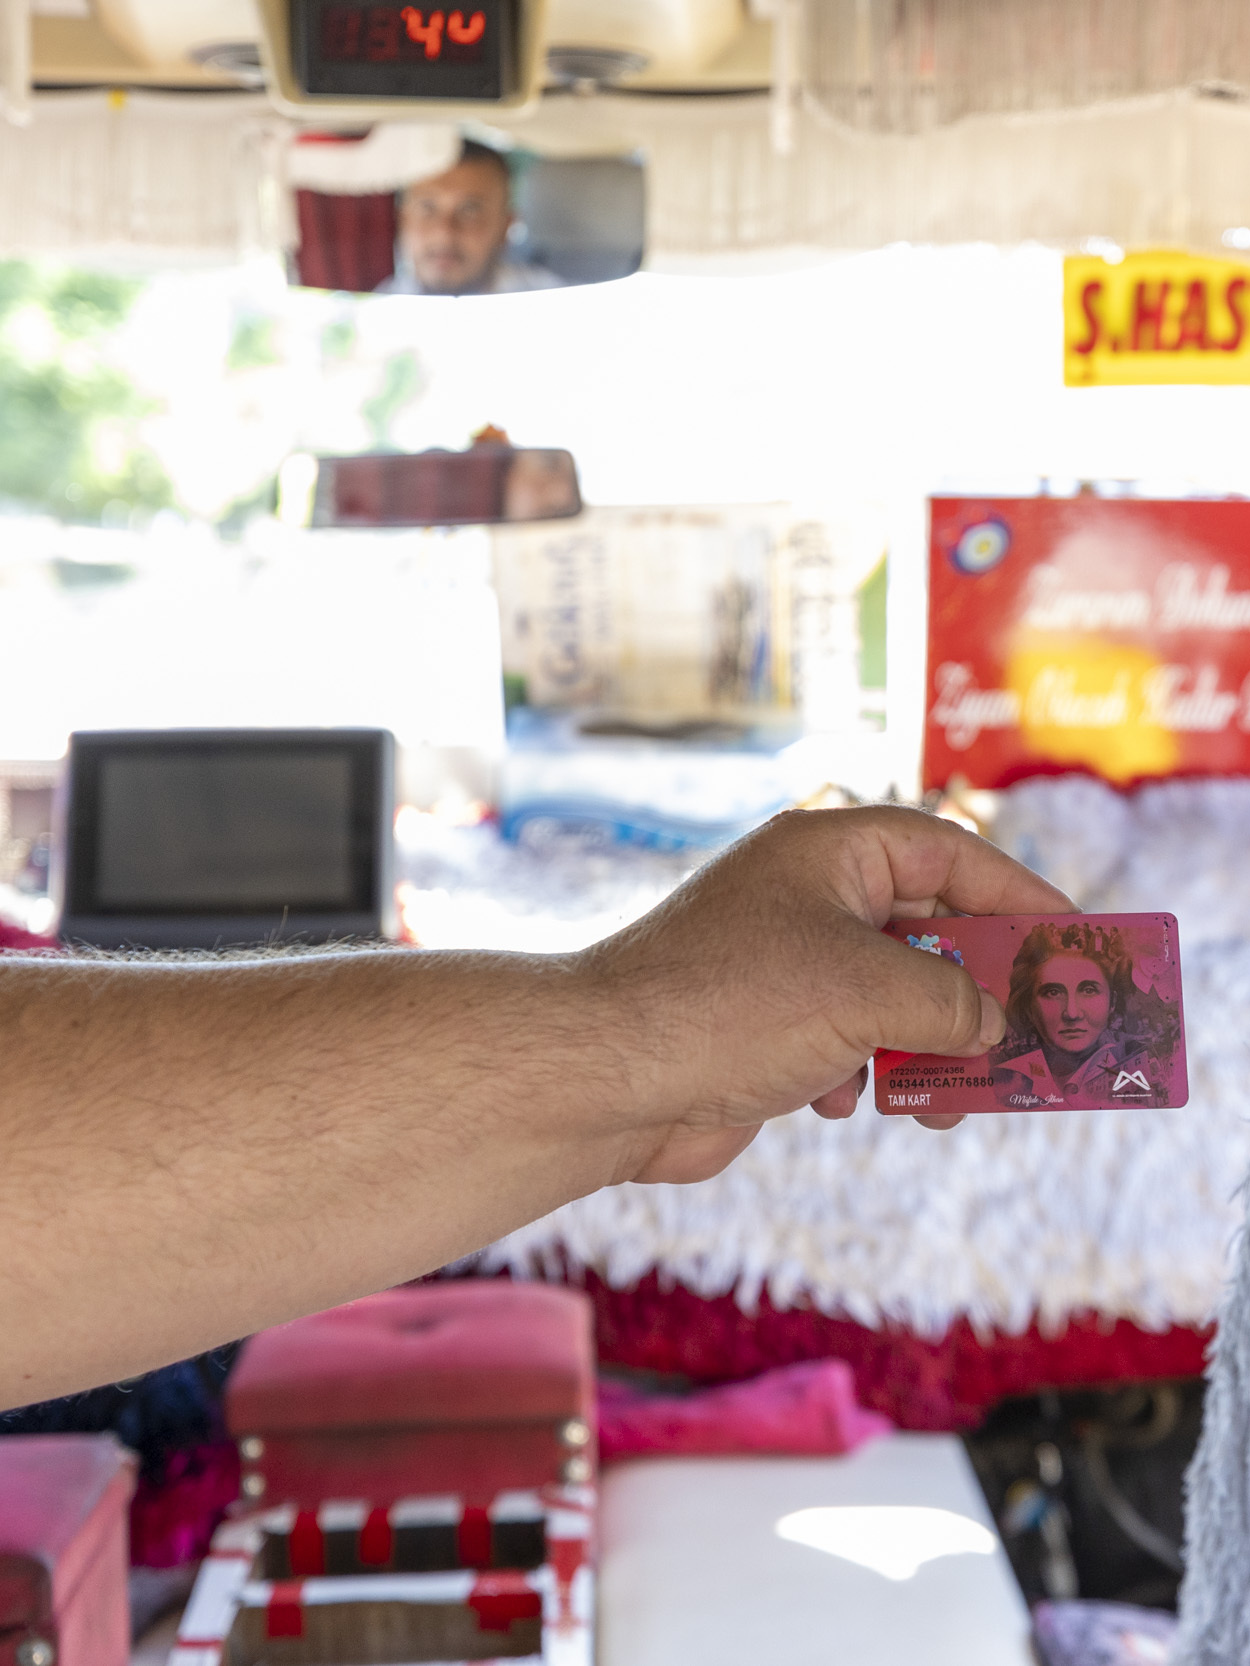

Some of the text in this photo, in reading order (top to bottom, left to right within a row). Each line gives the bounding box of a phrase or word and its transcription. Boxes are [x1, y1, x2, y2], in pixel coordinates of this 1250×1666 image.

[889, 1077, 994, 1089] 043441CA776880
[888, 1094, 931, 1106] TAM KART
